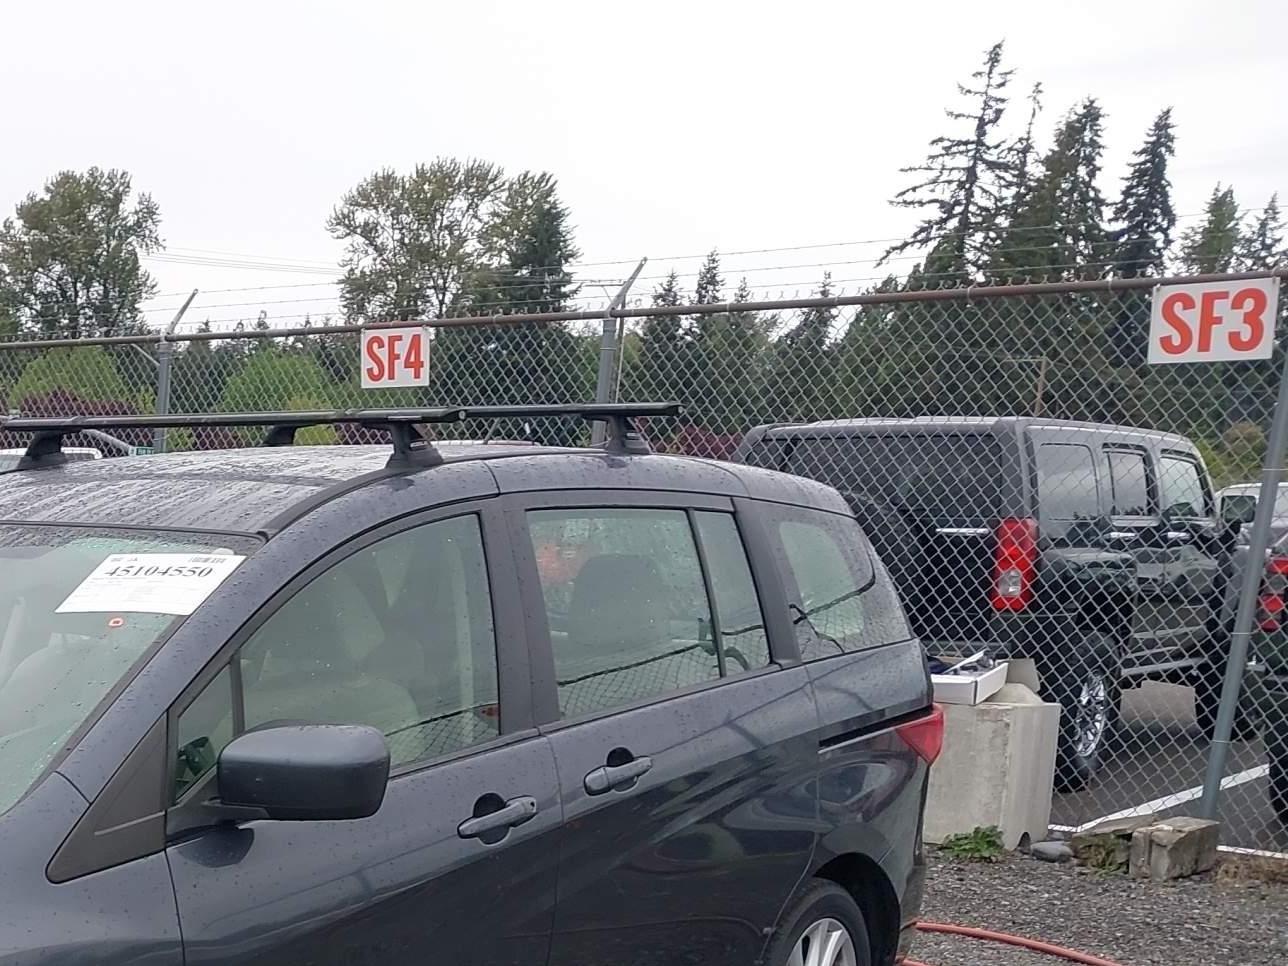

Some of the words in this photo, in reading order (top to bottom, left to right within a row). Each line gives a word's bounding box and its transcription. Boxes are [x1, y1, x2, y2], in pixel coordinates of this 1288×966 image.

[1159, 287, 1268, 355] SF3
[366, 333, 425, 382] SF4
[104, 565, 214, 578] 45104550
